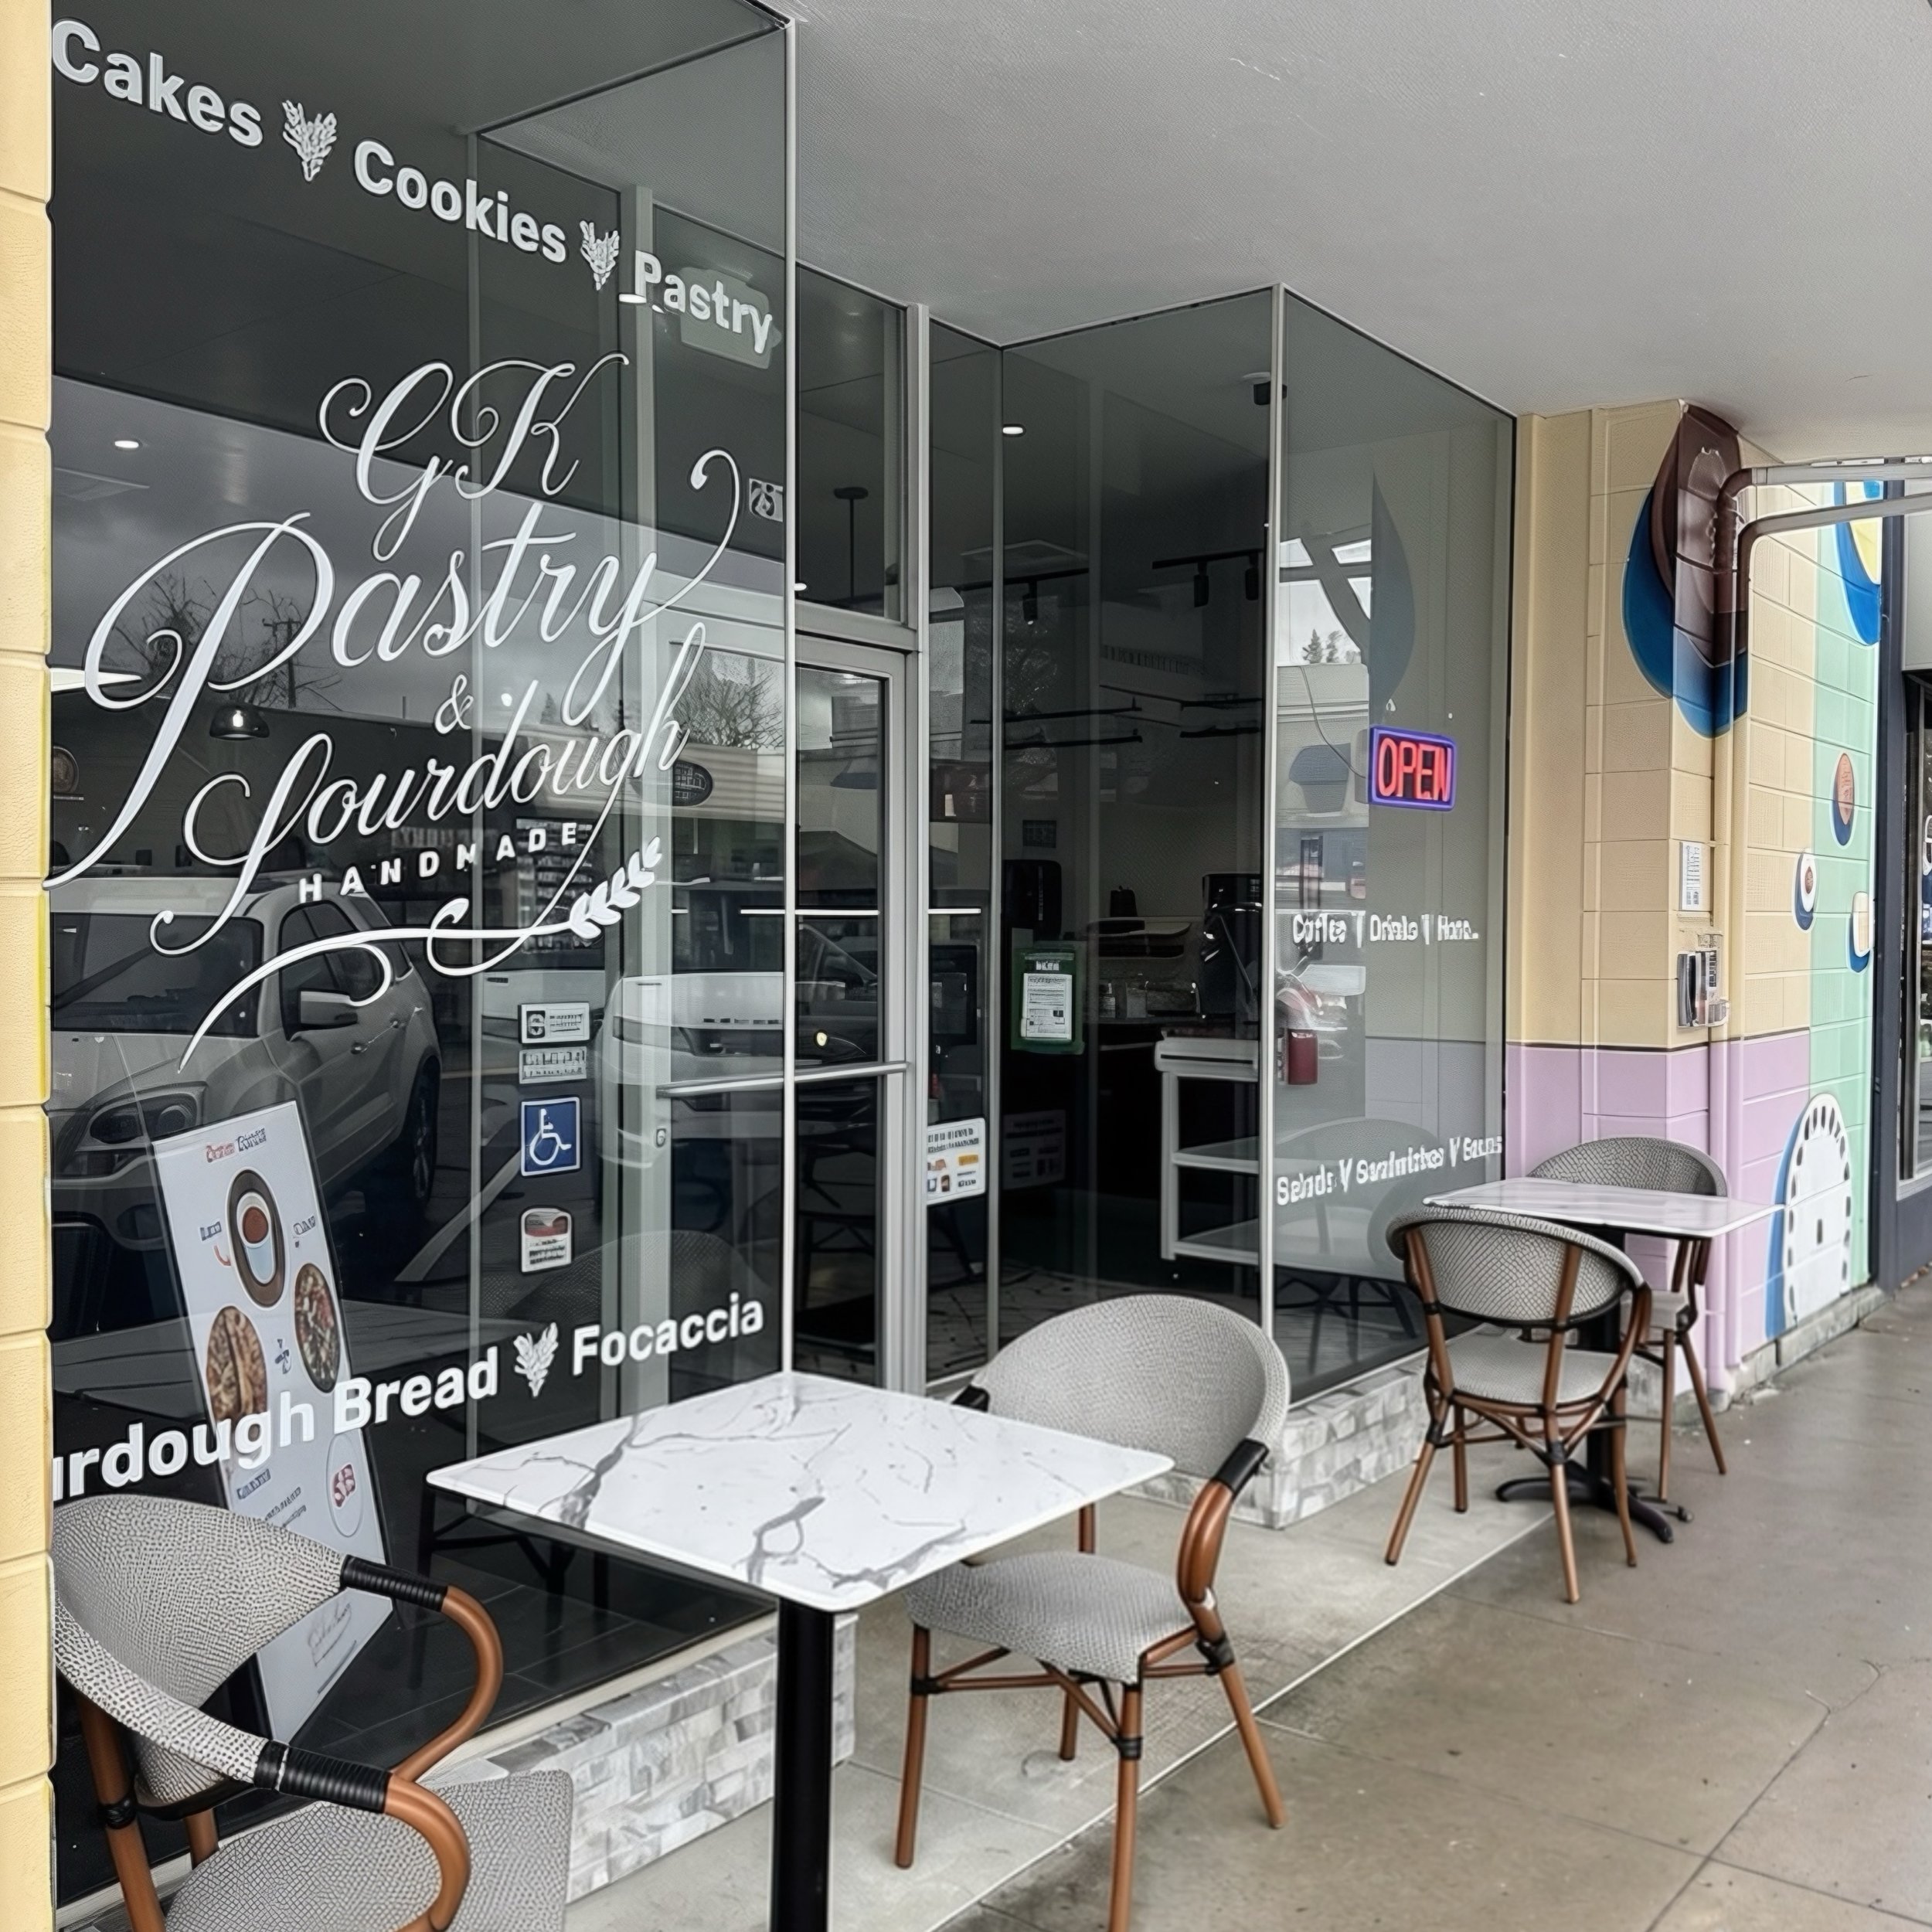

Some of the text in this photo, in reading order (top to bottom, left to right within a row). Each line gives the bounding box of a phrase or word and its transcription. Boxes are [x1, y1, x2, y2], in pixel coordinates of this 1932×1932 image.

[52, 20, 773, 354] Cakes Cookies Pastry
[318, 353, 629, 561] GK
[43, 450, 740, 889] Pastry
[435, 674, 474, 735] &
[1377, 736, 1451, 802] OPEN
[150, 621, 706, 956] Sourdough
[333, 1350, 498, 1434] Bread
[572, 1291, 765, 1377] Focaccia
